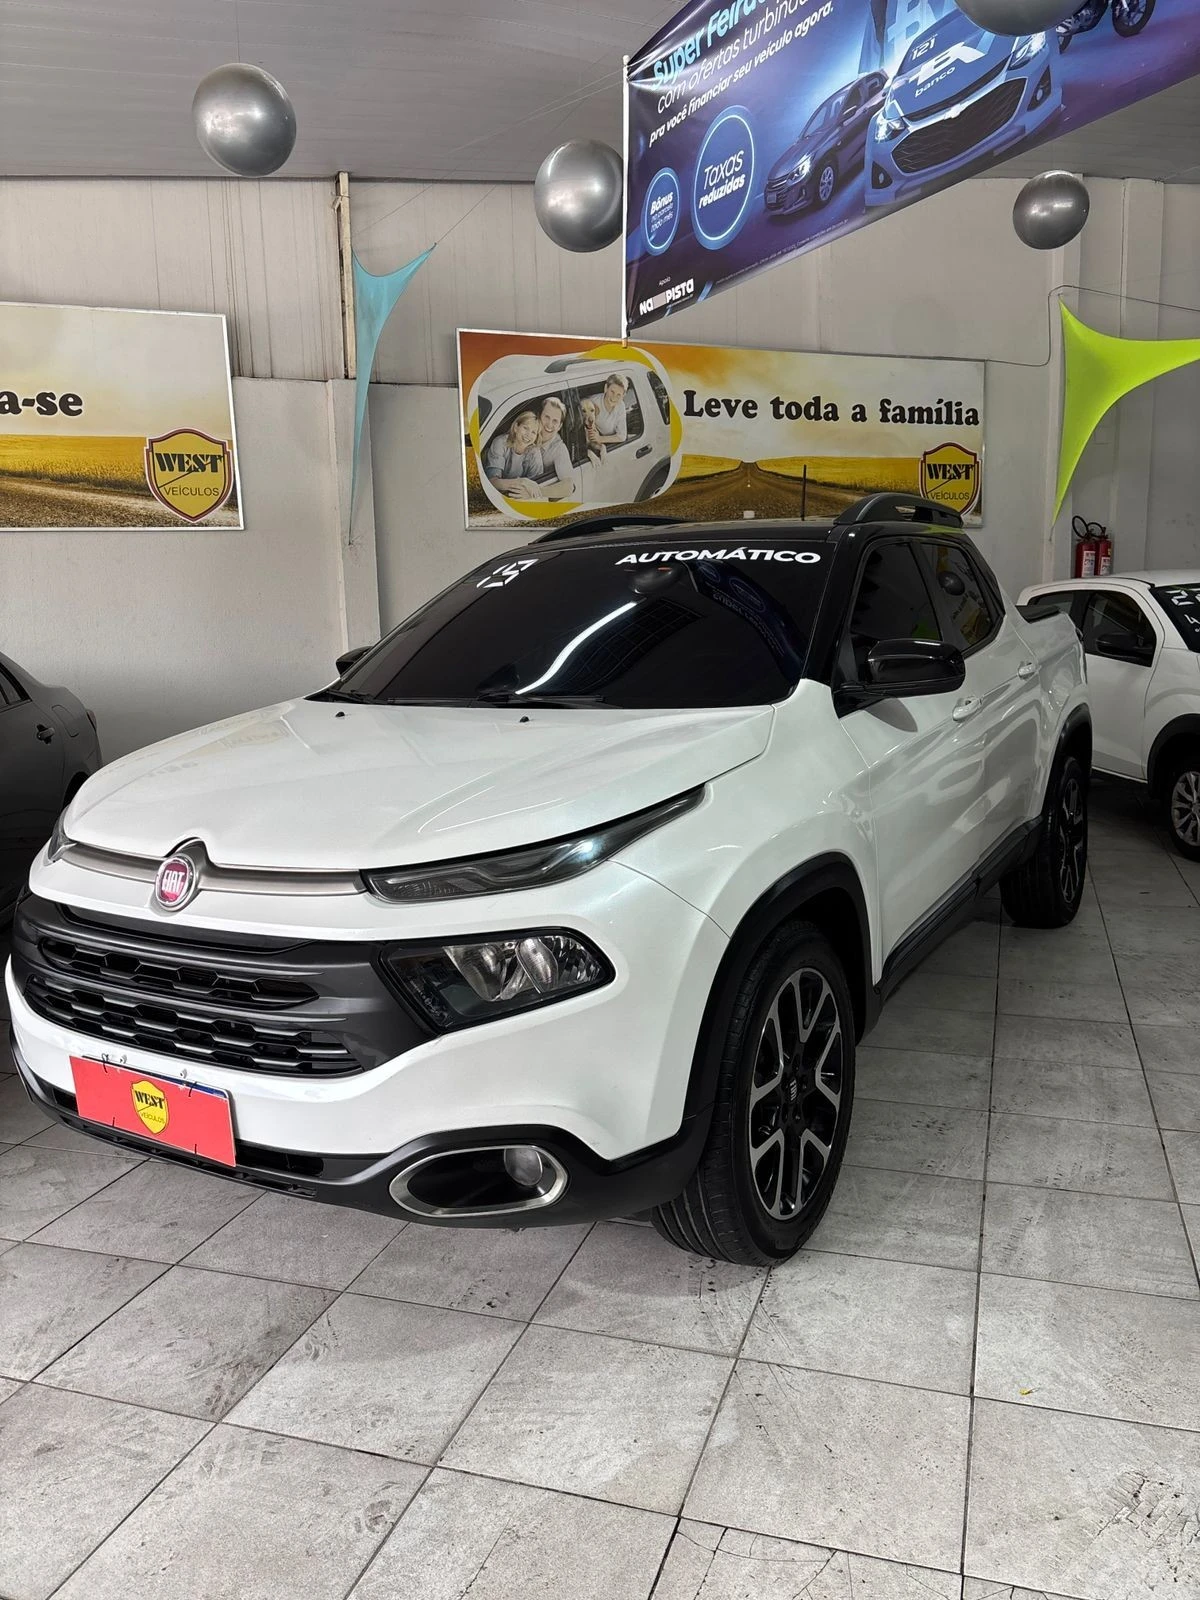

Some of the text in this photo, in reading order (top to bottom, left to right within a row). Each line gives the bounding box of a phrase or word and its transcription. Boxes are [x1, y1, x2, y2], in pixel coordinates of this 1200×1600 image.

[658, 0, 809, 114] com ofertas turbina
[649, 0, 835, 149] pra você financiar seu veículo agora.
[914, 66, 956, 98] banco
[703, 150, 744, 191] Taxas
[650, 191, 673, 215] Bônus
[698, 173, 746, 209] reduzidas
[683, 389, 980, 426] Leve toda a família
[155, 453, 223, 473] WEST
[926, 463, 974, 480] WEST
[614, 546, 821, 565] AUTOMÁTICO
[161, 870, 186, 893] FIAT
[135, 1090, 165, 1110] WEST
